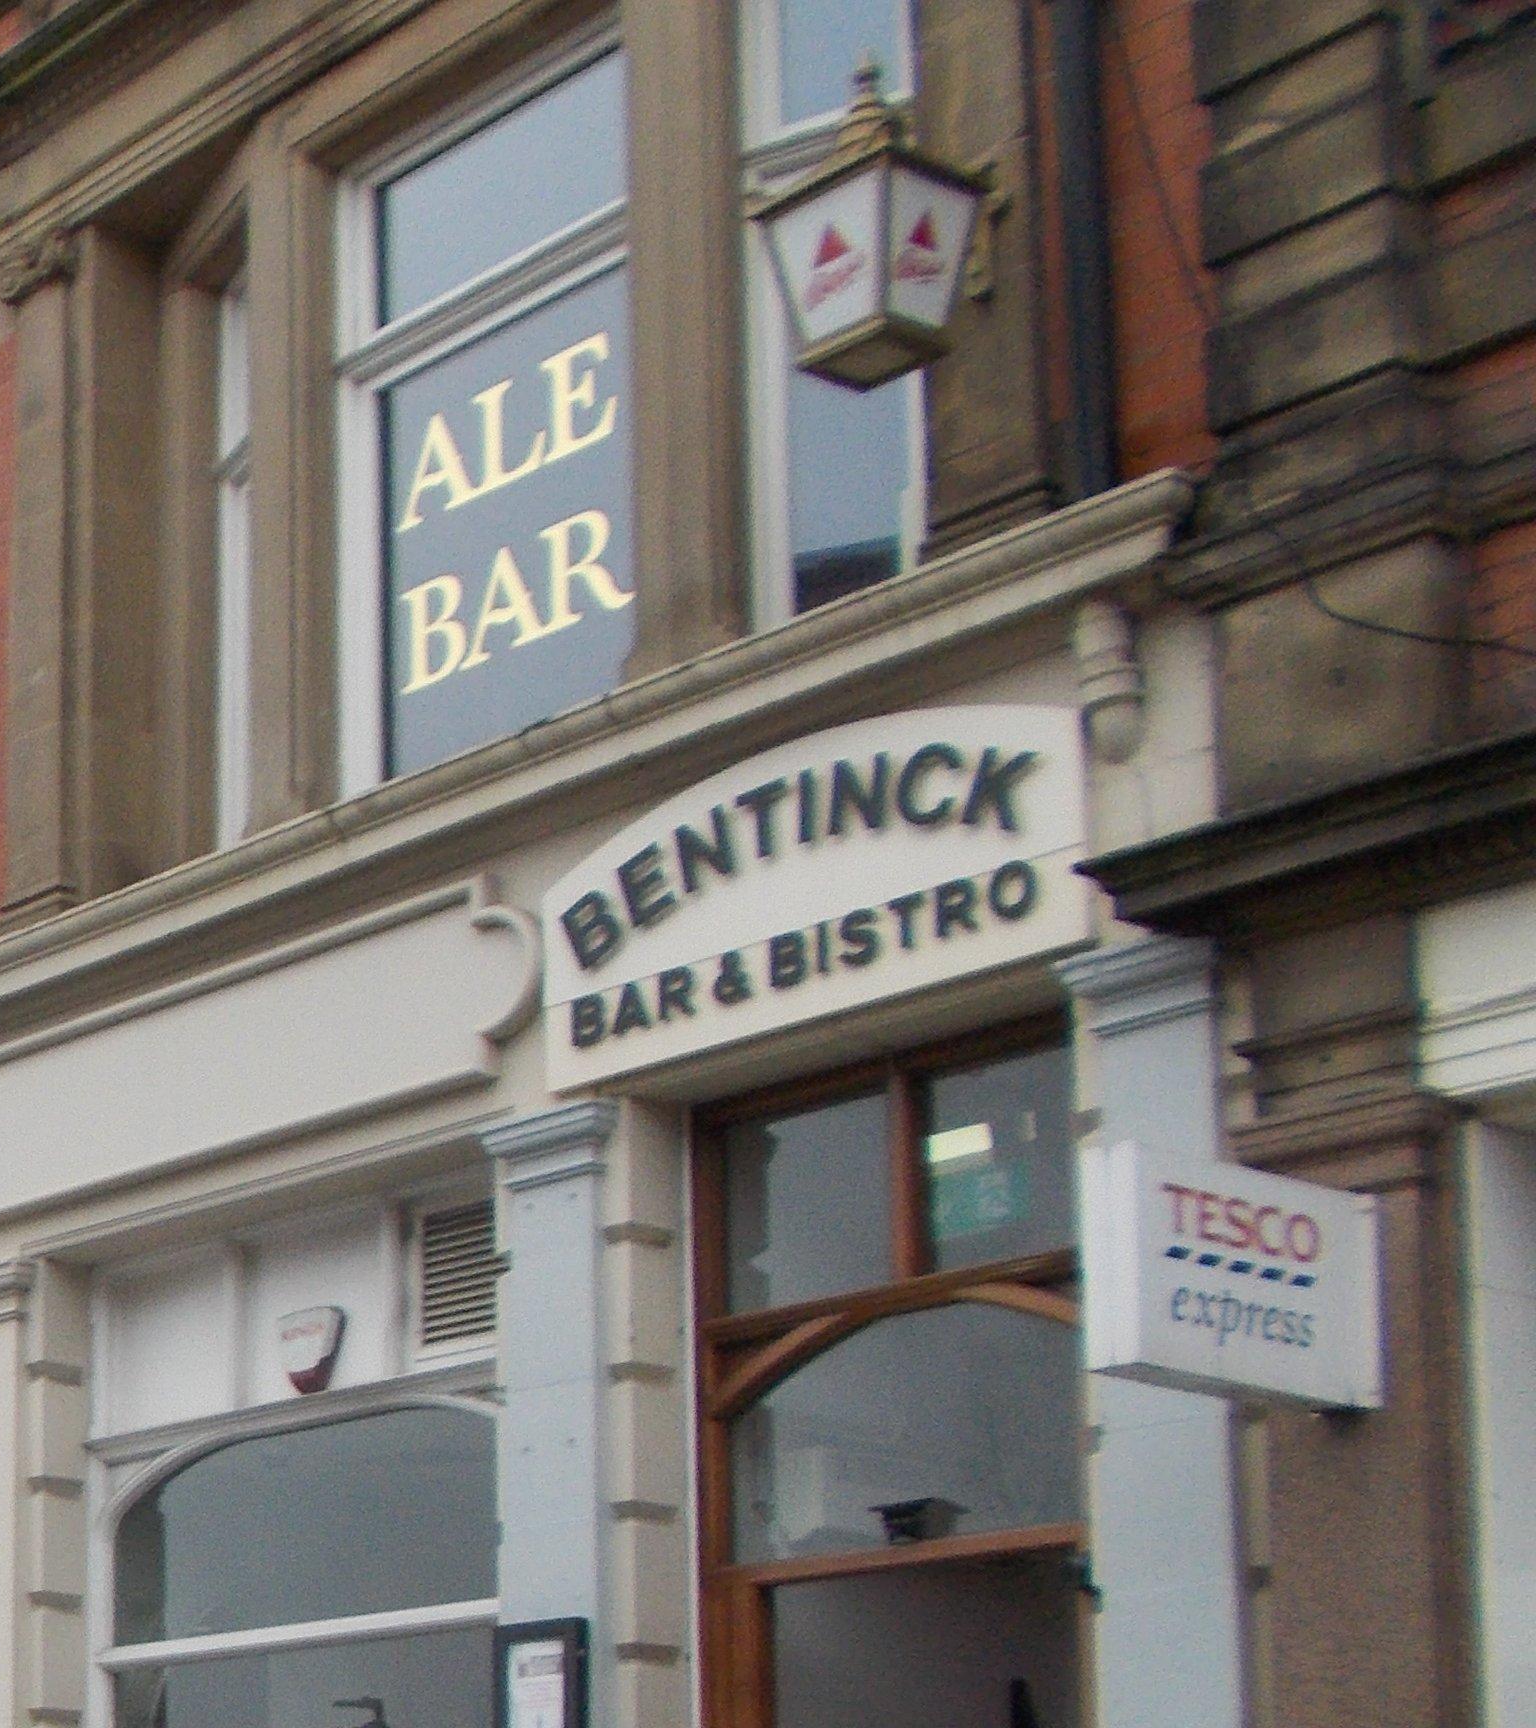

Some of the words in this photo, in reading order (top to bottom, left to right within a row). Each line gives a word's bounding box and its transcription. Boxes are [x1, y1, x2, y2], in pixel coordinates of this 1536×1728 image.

[395, 331, 618, 533] ALE
[400, 509, 637, 696] BAR
[560, 741, 1039, 970] BENTINCK
[570, 965, 696, 1049] BAR
[712, 948, 751, 1003] &
[768, 860, 1038, 989] BISTRO
[1162, 1182, 1322, 1263] TESCO
[1171, 1286, 1316, 1347] express
